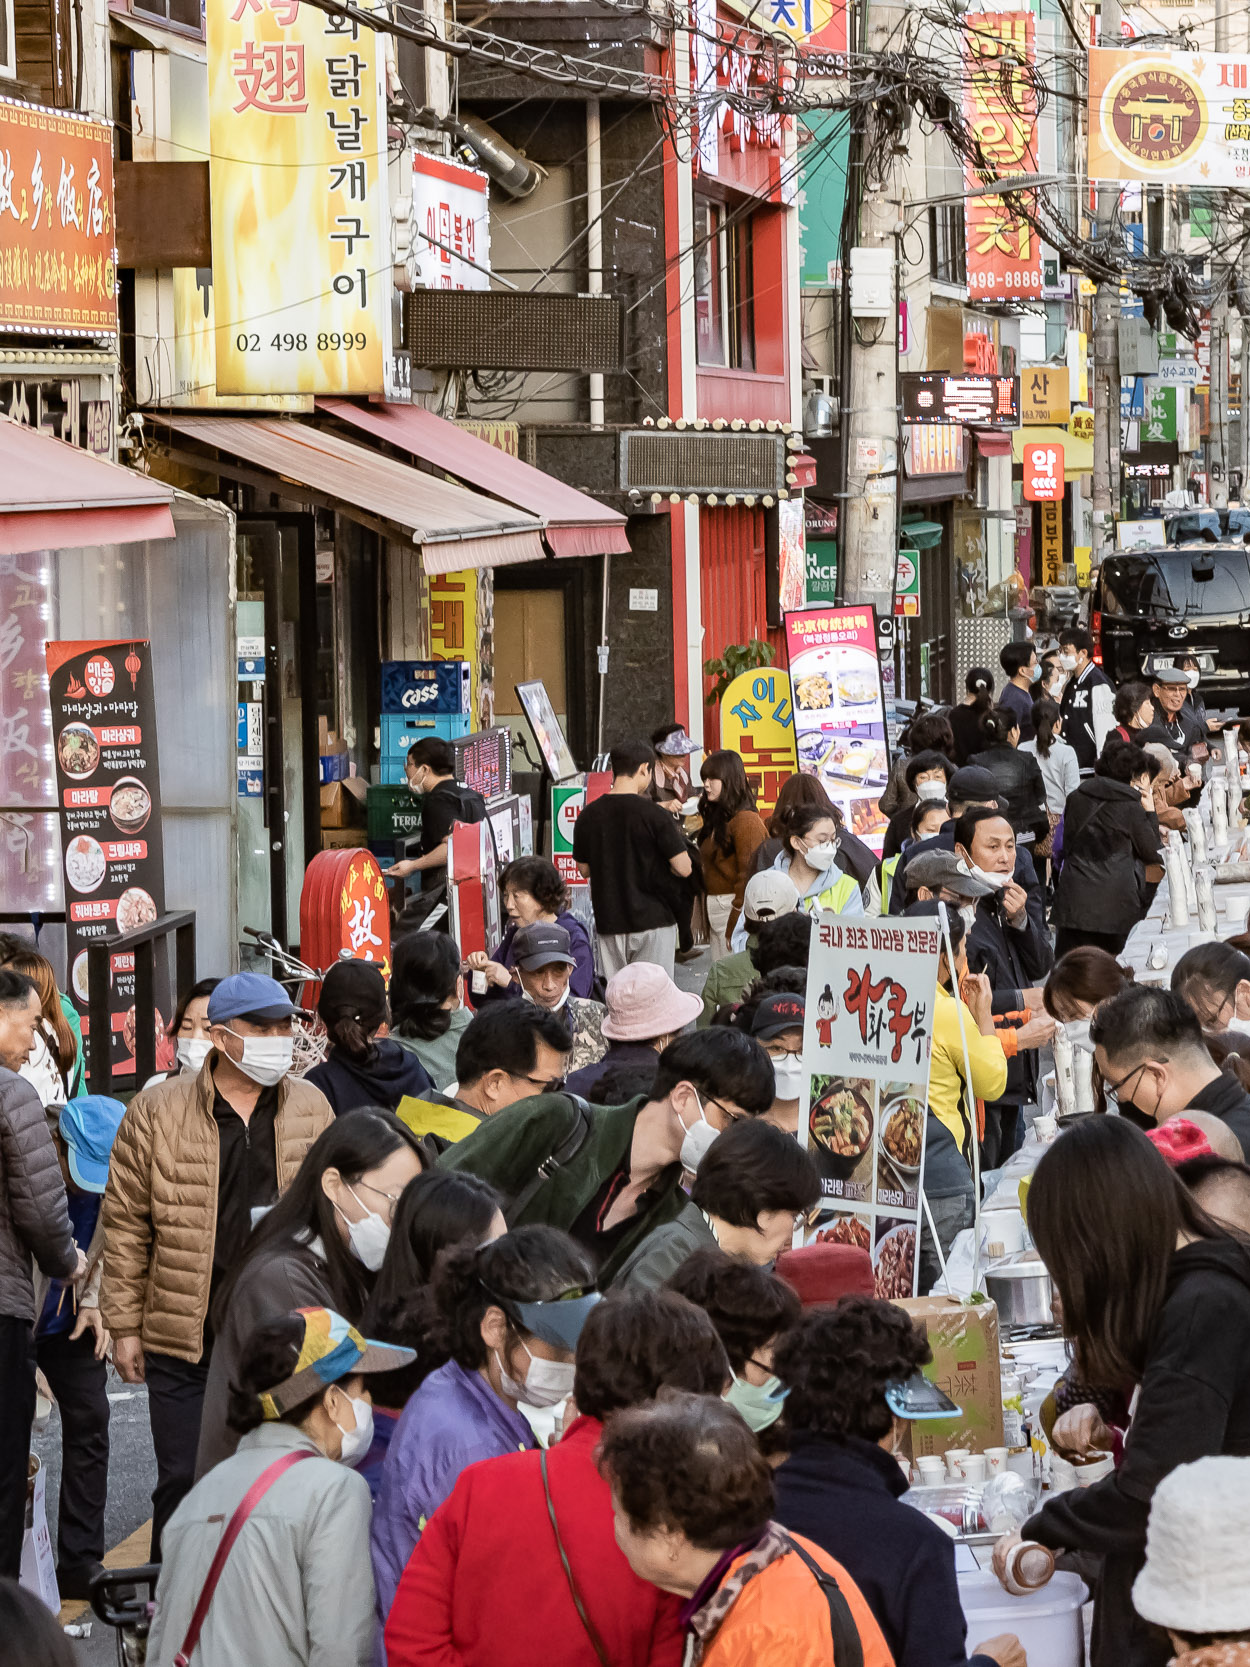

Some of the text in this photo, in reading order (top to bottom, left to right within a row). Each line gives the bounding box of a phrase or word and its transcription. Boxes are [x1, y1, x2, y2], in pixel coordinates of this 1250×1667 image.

[969, 271, 1040, 288] 498-8886
[236, 332, 367, 352] 02 498 8999
[1161, 366, 1198, 379] 성수교회
[1031, 449, 1057, 477] 약
[1073, 690, 1089, 708] K
[819, 925, 939, 955] 국내 최초 마라탕 전문점
